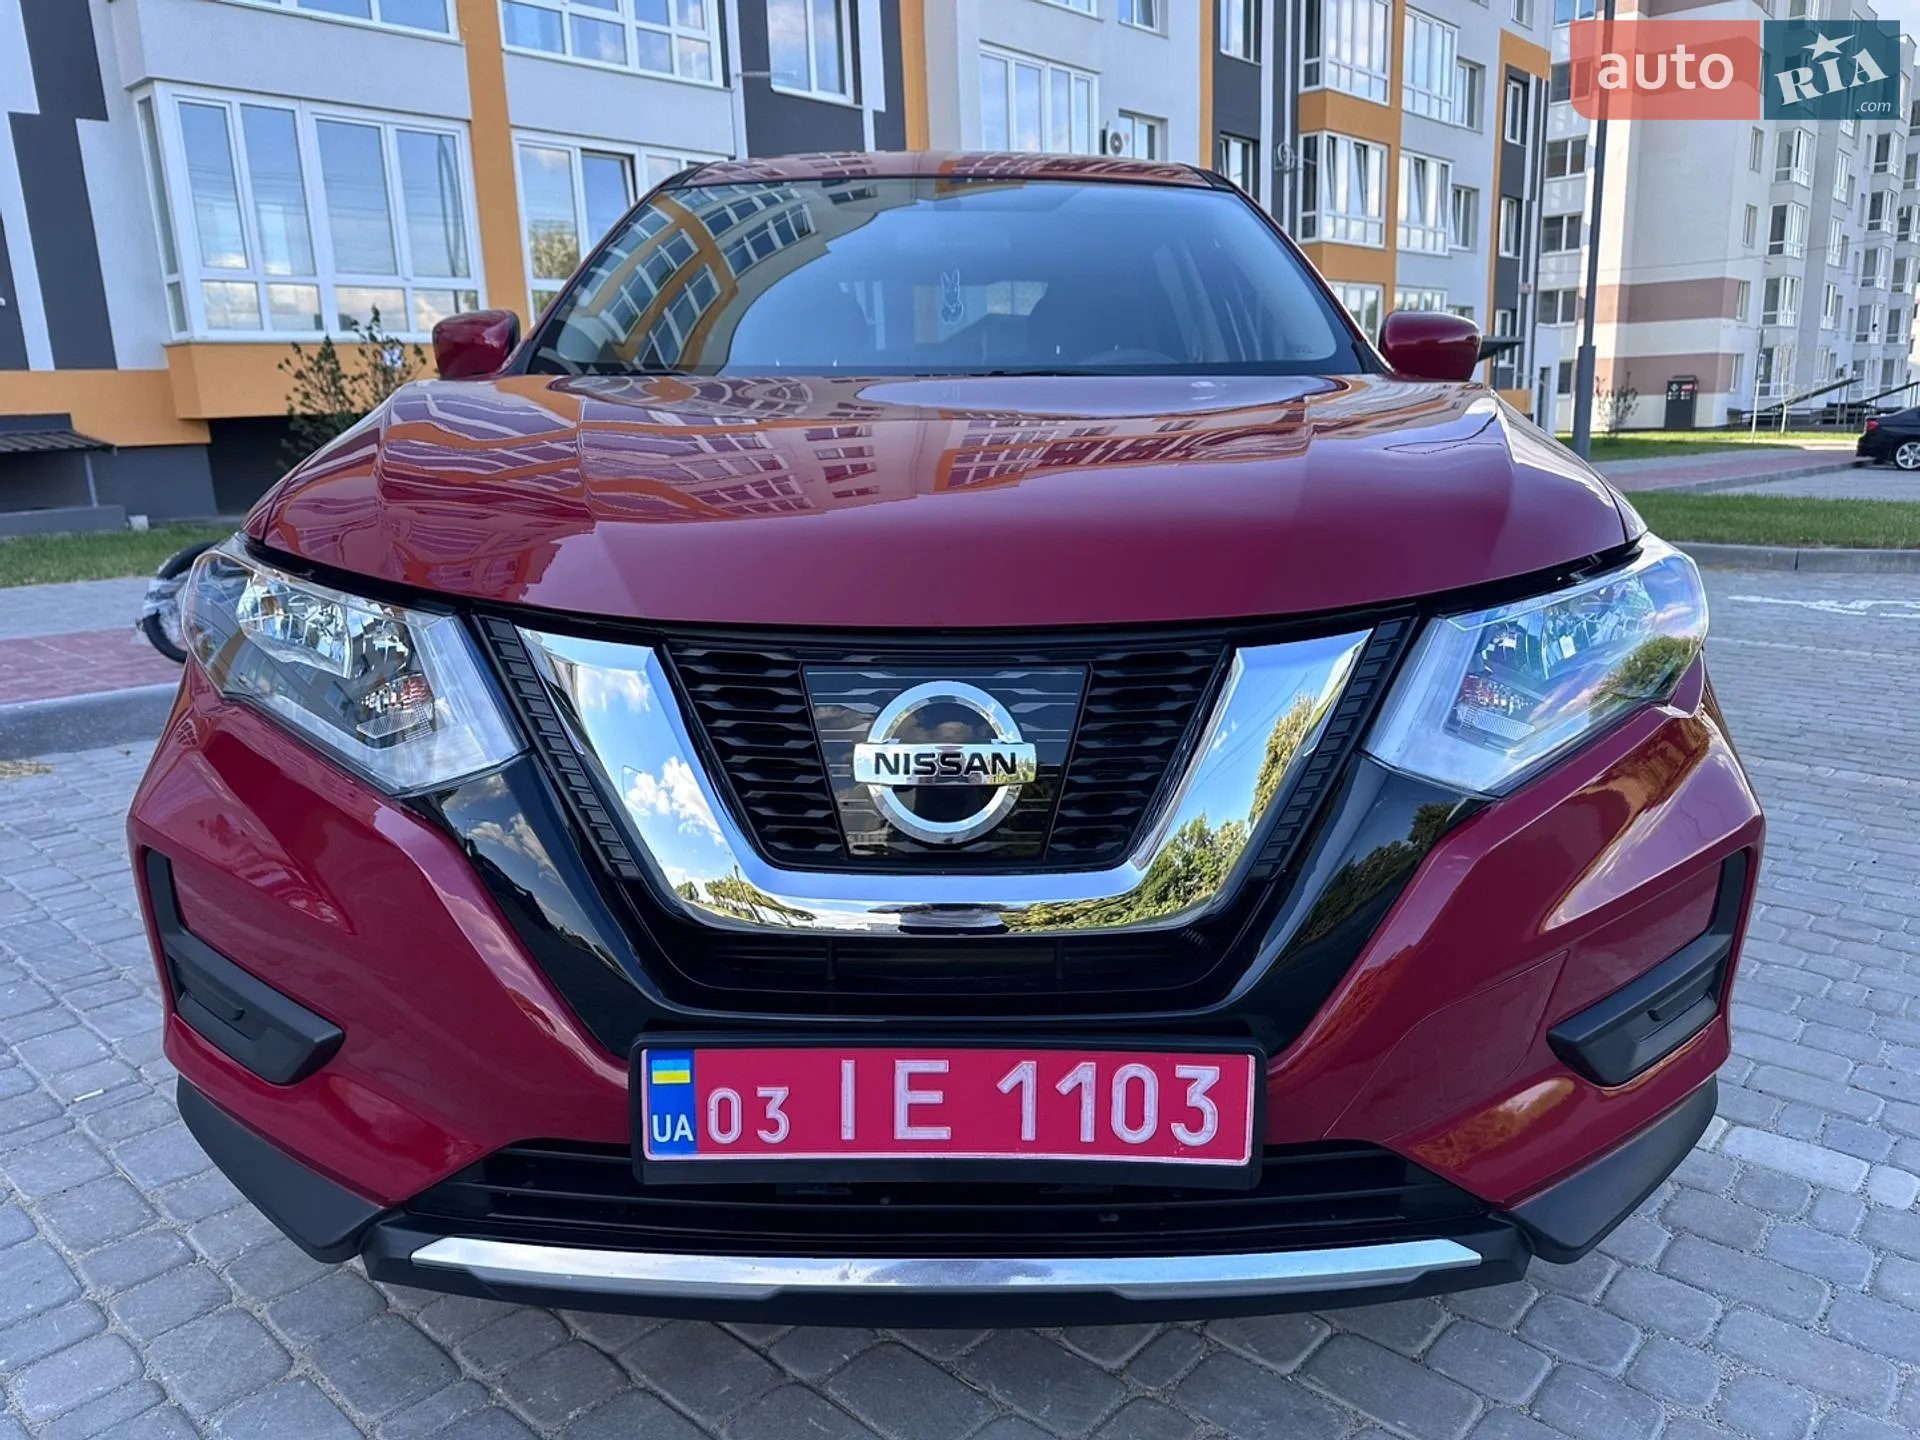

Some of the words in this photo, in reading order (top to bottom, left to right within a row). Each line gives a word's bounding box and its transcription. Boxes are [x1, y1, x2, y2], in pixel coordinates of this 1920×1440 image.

[875, 752, 1017, 776] NISSAN
[706, 1086, 791, 1144] 03
[997, 1060, 1221, 1146] 1103
[652, 1114, 694, 1142] UA
